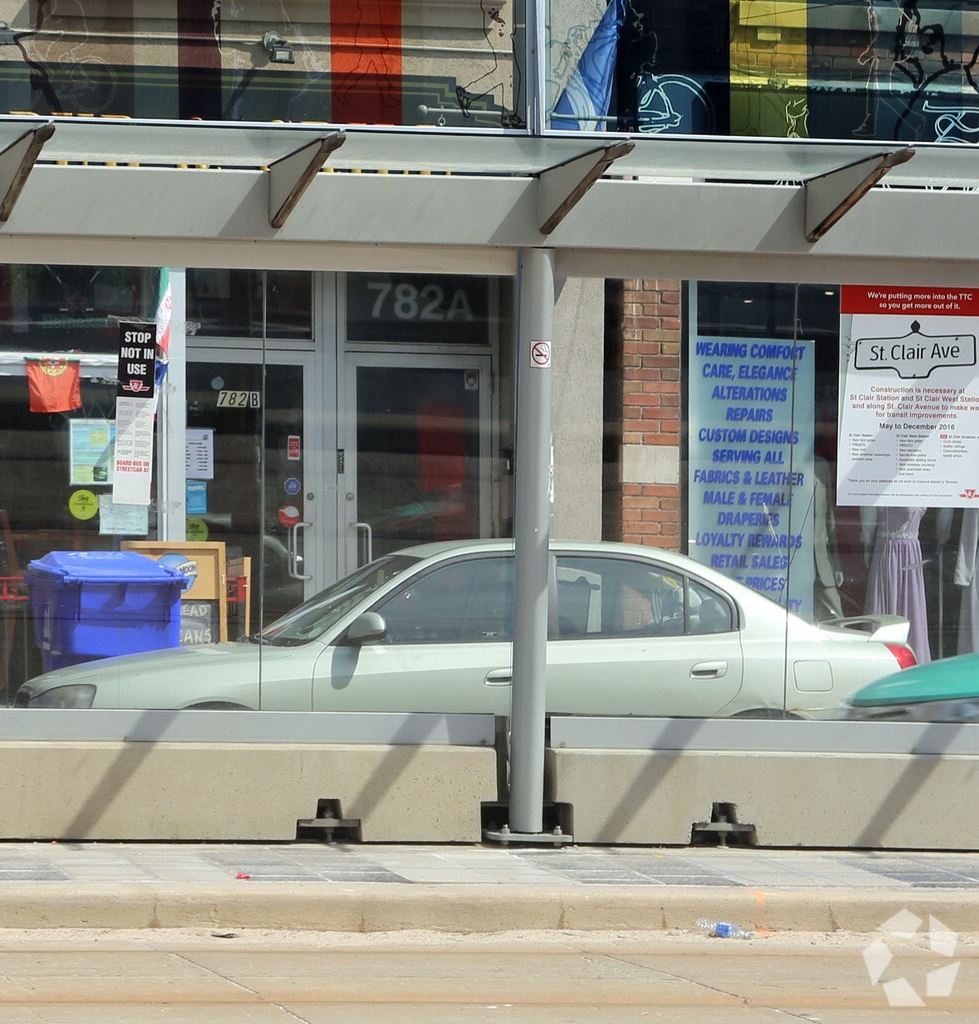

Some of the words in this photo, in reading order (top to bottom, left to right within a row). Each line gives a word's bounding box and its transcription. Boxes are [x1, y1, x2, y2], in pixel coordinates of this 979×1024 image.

[367, 282, 474, 321] 782A
[867, 291, 887, 299] We're
[889, 293, 912, 301] putting
[959, 293, 973, 301] TTC
[124, 331, 152, 344] STOP
[121, 347, 142, 359] NOT
[143, 348, 154, 360] IN
[696, 342, 748, 358] WEARING
[750, 344, 806, 360] COMFORT
[869, 345, 888, 361] St.
[890, 344, 927, 361] Clair
[930, 343, 960, 359] Ave
[127, 363, 147, 375] USE
[702, 363, 736, 381] CARE,
[738, 365, 799, 382] ELEGANCE
[711, 385, 788, 402] ALTERATIONS
[922, 387, 957, 395] necessary
[726, 407, 773, 422] REPAIRS
[866, 403, 885, 411] along
[879, 422, 893, 430] May
[903, 422, 937, 430] December
[698, 428, 747, 444] CUSTOM
[749, 429, 799, 445] DESIGNS
[712, 449, 761, 464] SERVING
[763, 450, 784, 465] ALL
[693, 469, 740, 484] FABRICS
[743, 471, 753, 485] &
[755, 471, 804, 486] LEATHER
[703, 491, 736, 505] MALE
[738, 491, 747, 506] &
[749, 492, 795, 507] FEMALE
[717, 512, 780, 527] DRAPERIES
[696, 532, 745, 548] LOYALTY
[748, 533, 803, 549] REWARDS
[711, 554, 748, 568] RETAIL
[752, 555, 789, 570] SALES
[746, 577, 785, 591] PRICES
[181, 604, 208, 617] EAD
